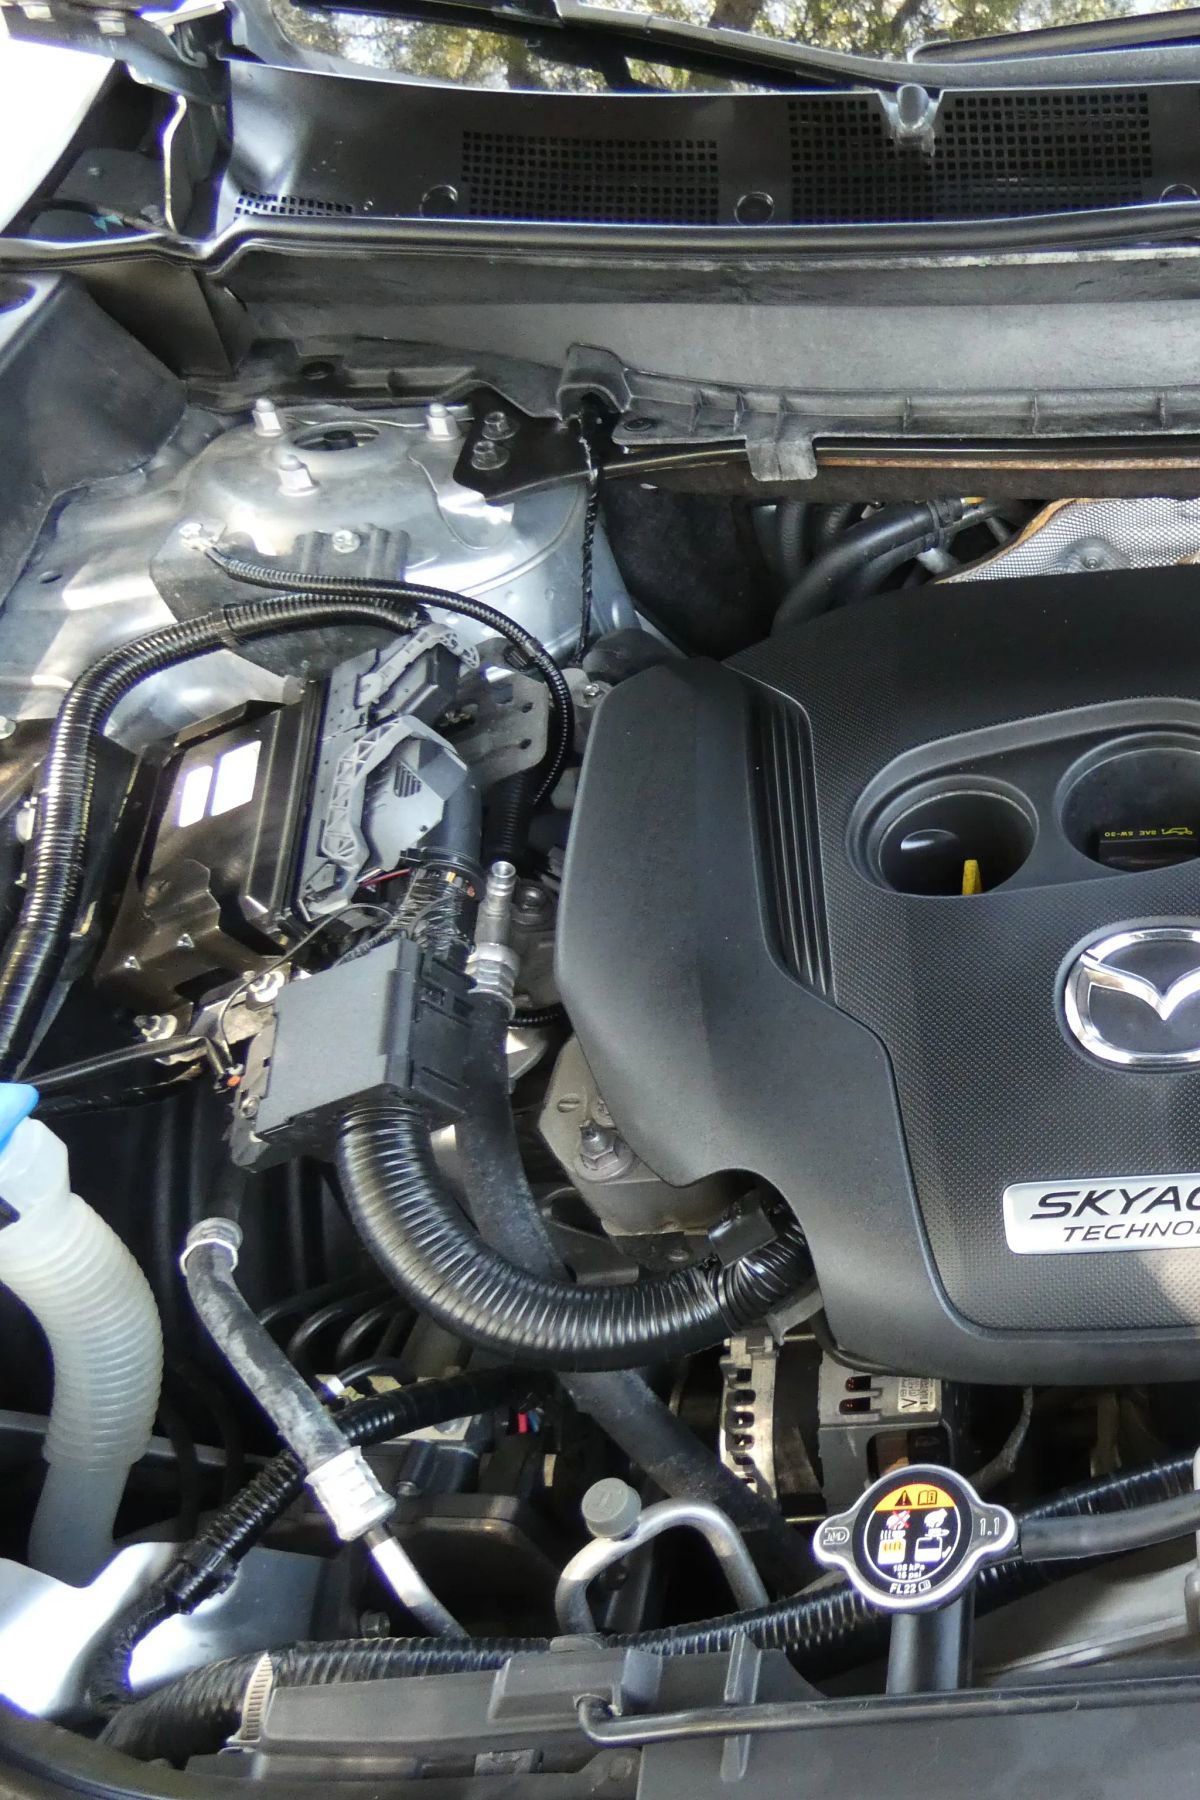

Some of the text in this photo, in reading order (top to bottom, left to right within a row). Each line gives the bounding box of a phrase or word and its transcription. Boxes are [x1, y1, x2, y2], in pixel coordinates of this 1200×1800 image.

[979, 1517, 1001, 1536] 1.1
[908, 1562, 926, 1573] kPa
[907, 1571, 922, 1580] psi
[889, 1582, 917, 1595] FL22
